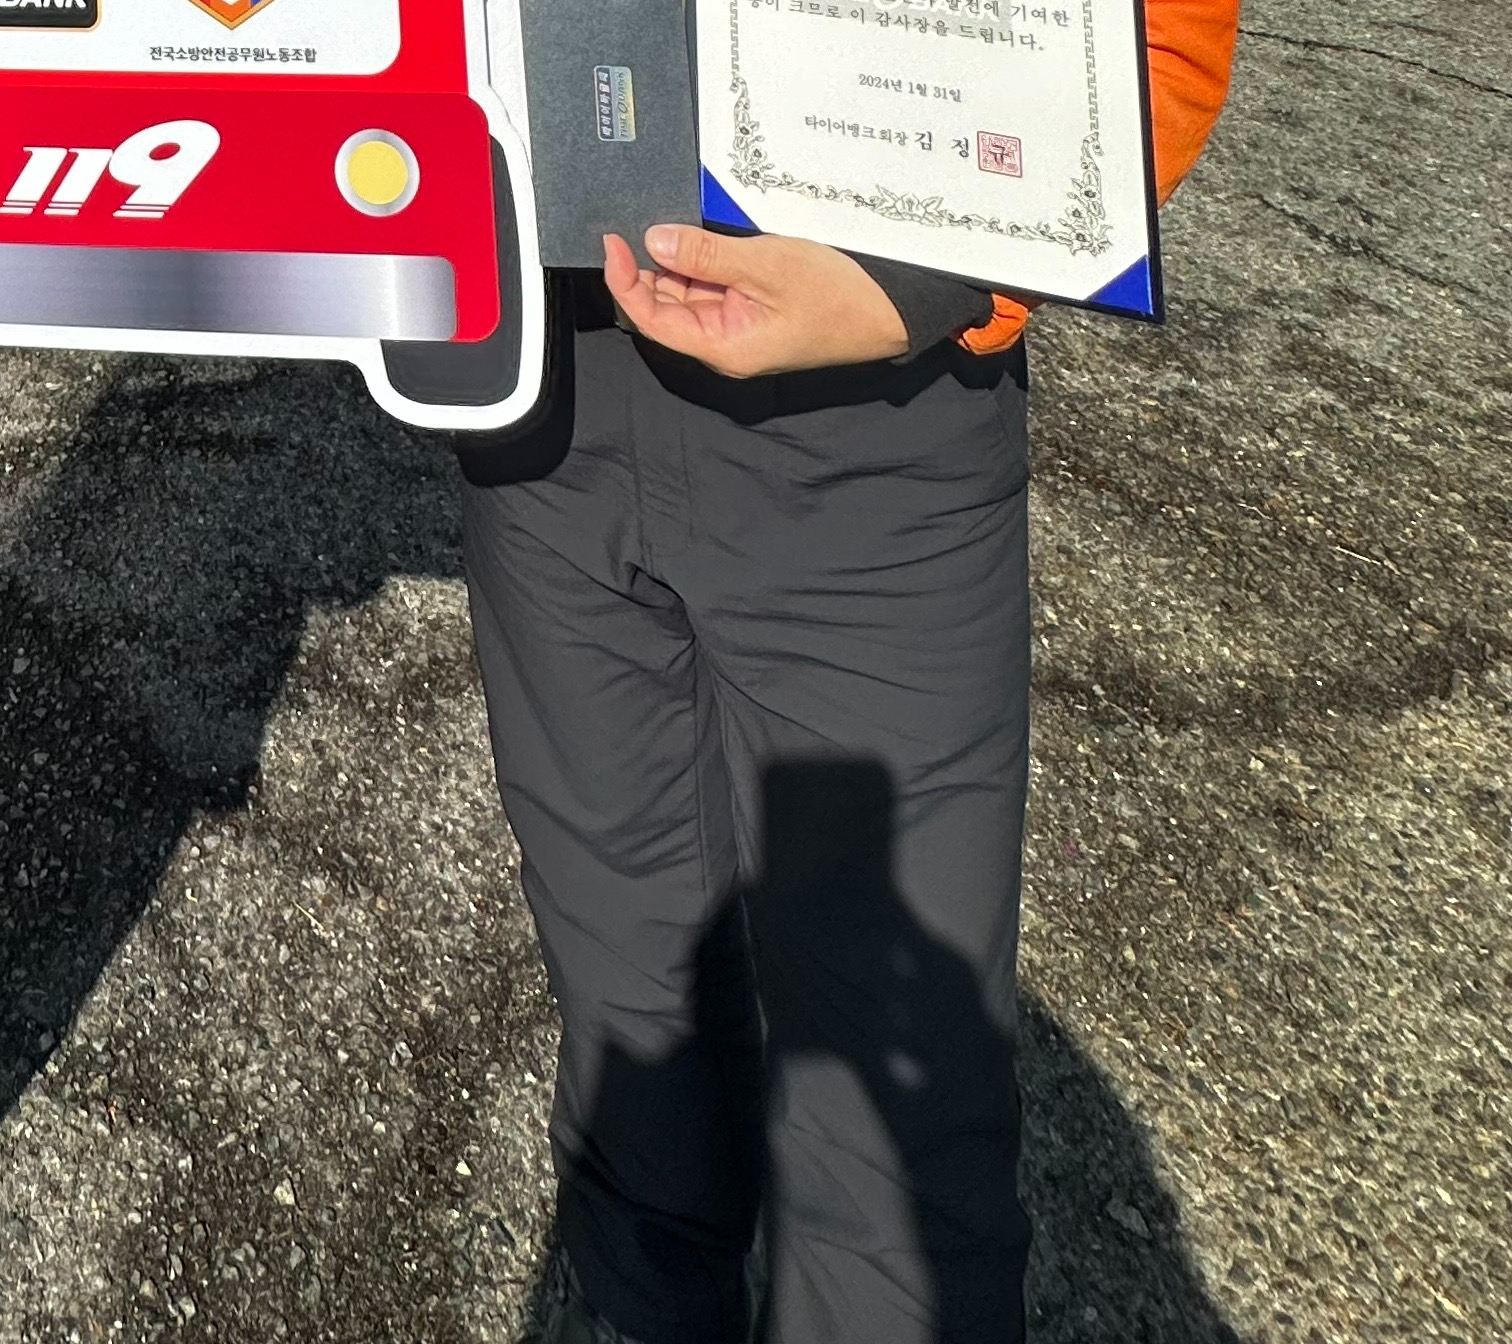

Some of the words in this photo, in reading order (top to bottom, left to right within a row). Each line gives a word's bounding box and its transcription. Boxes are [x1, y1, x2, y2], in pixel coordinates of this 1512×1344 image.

[788, 0, 843, 19] 크므로
[850, 7, 865, 24] 이
[875, 11, 950, 37] 감사장을
[1011, 4, 1071, 28] 기여한
[149, 45, 318, 64] 전국소방안전공무원노동조합
[858, 72, 903, 92] 2024년
[907, 82, 928, 97] 1월
[932, 86, 963, 103] 31일
